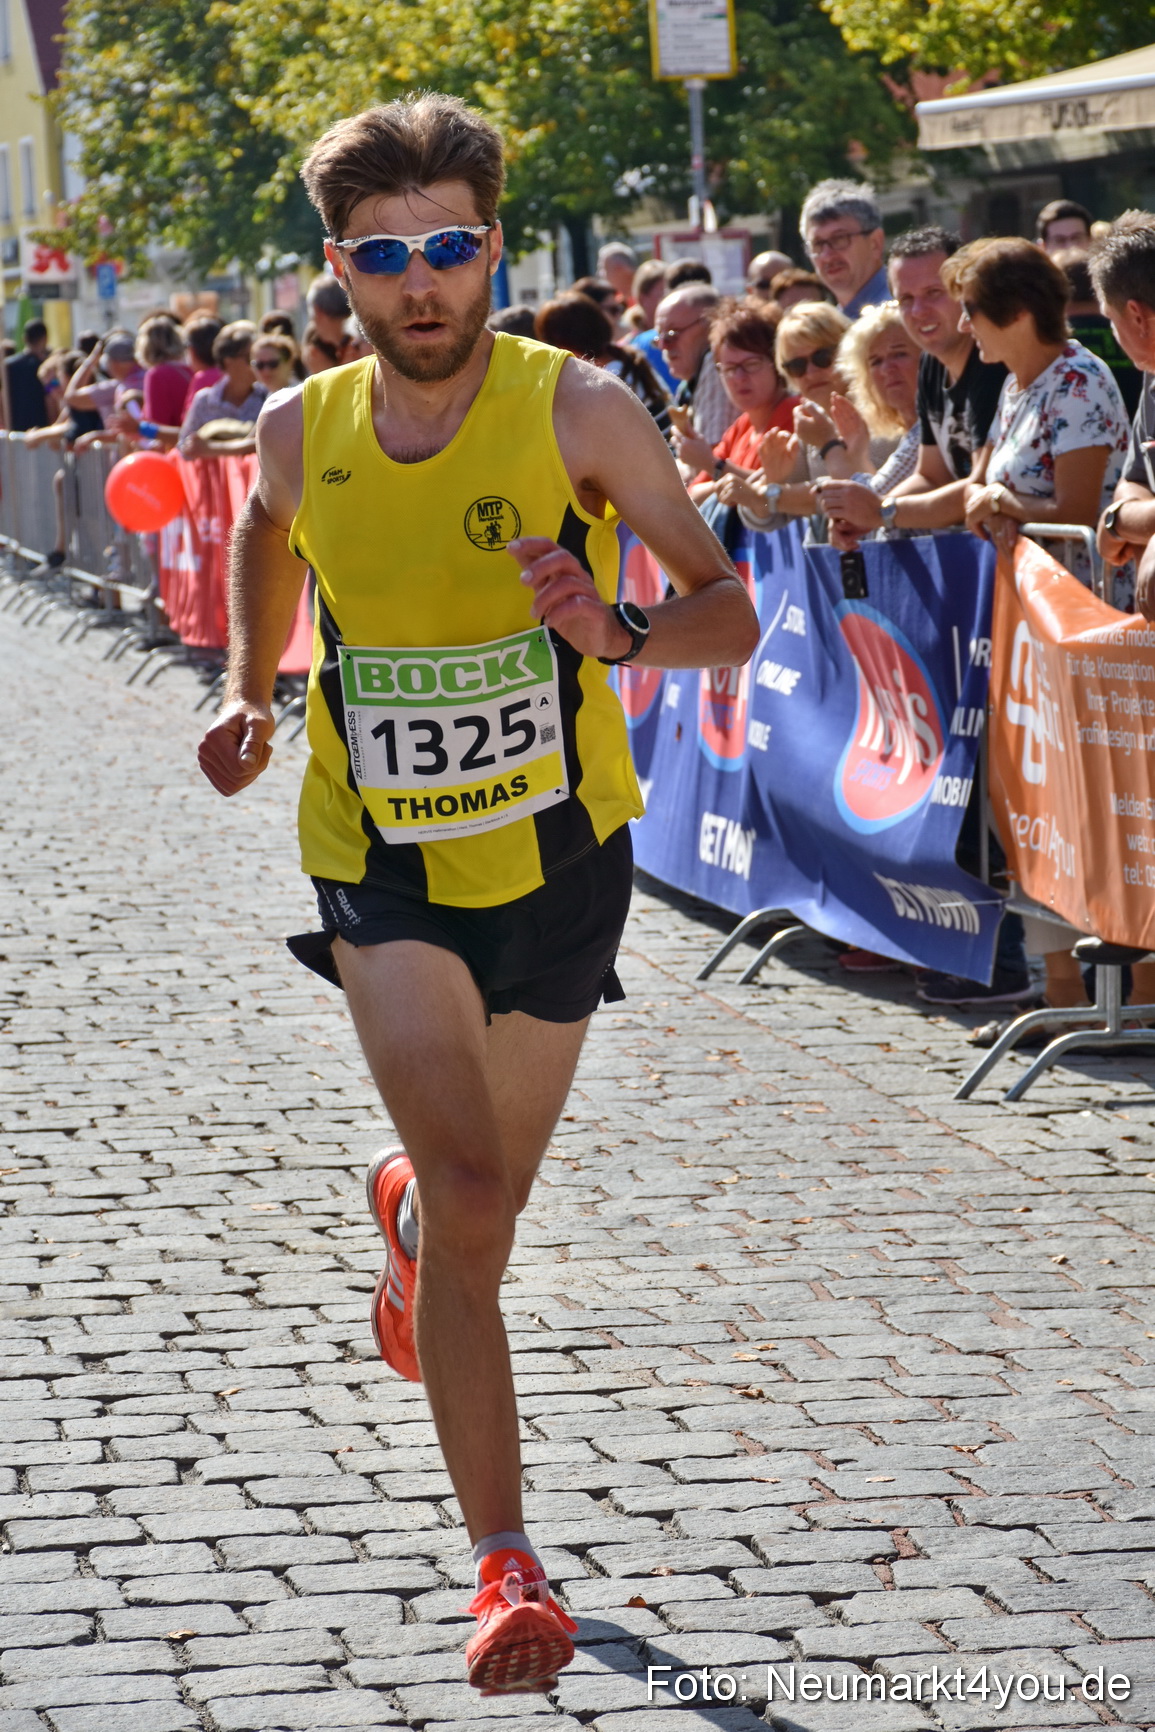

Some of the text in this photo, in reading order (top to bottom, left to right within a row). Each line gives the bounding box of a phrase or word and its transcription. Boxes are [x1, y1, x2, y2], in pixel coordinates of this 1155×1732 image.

[477, 501, 502, 518] MTP
[353, 641, 539, 699] BOCK
[756, 660, 801, 696] ONLINE
[370, 697, 537, 776] 1325
[387, 774, 529, 820] THOMAS
[336, 888, 358, 921] CRAFT
